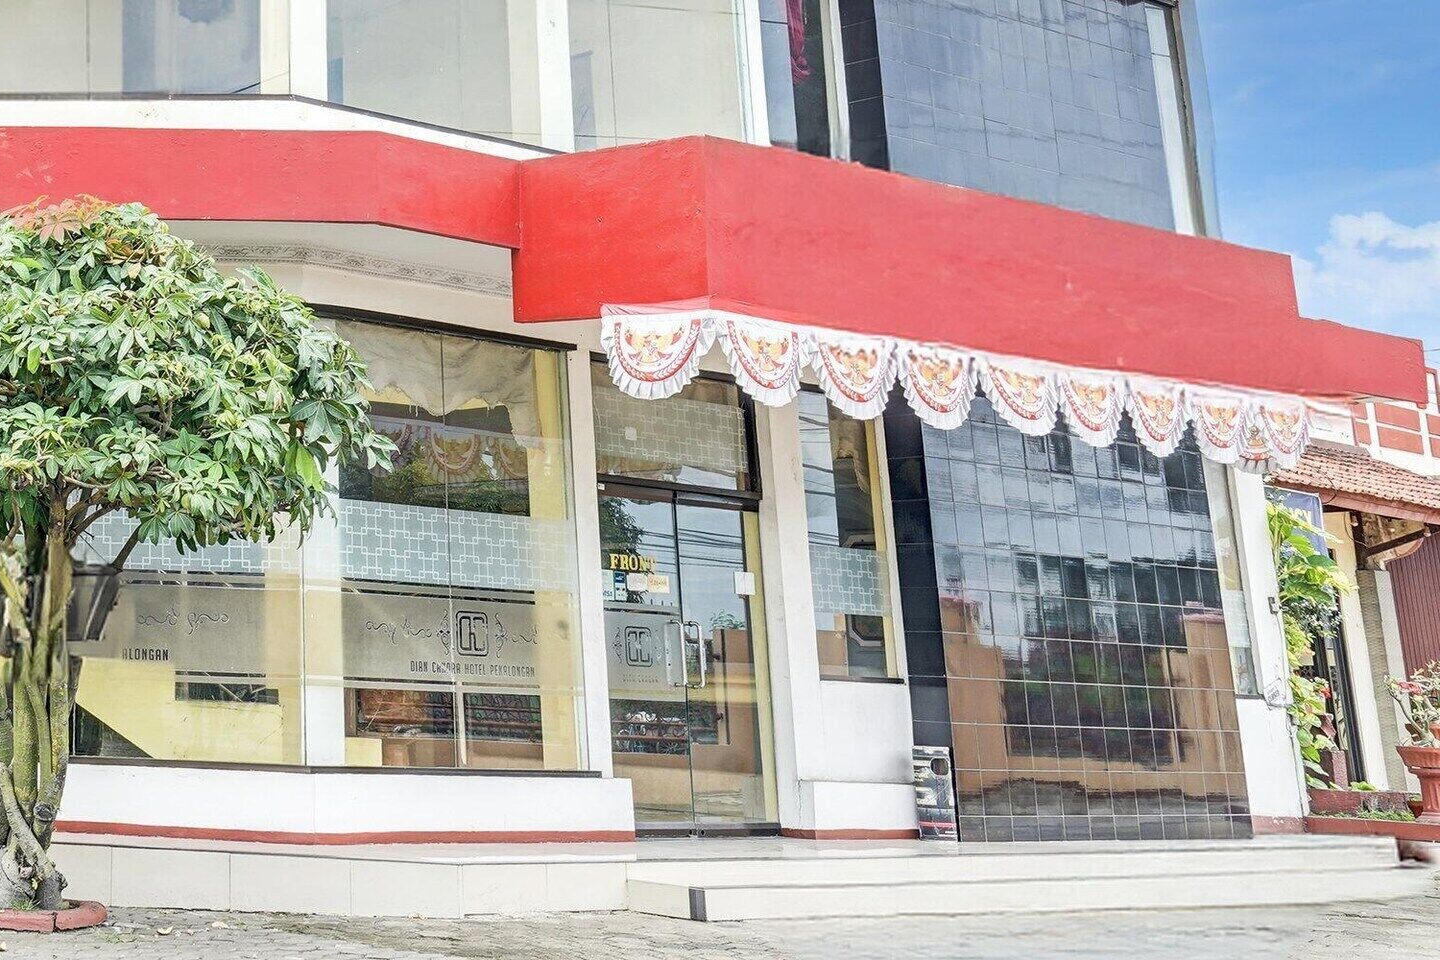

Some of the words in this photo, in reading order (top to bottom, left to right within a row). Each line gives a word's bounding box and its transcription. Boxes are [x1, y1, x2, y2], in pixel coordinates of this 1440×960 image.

[410, 660, 428, 672] DIAN
[464, 663, 486, 676] HOTEL
[489, 665, 535, 678] PEKALONGAN
